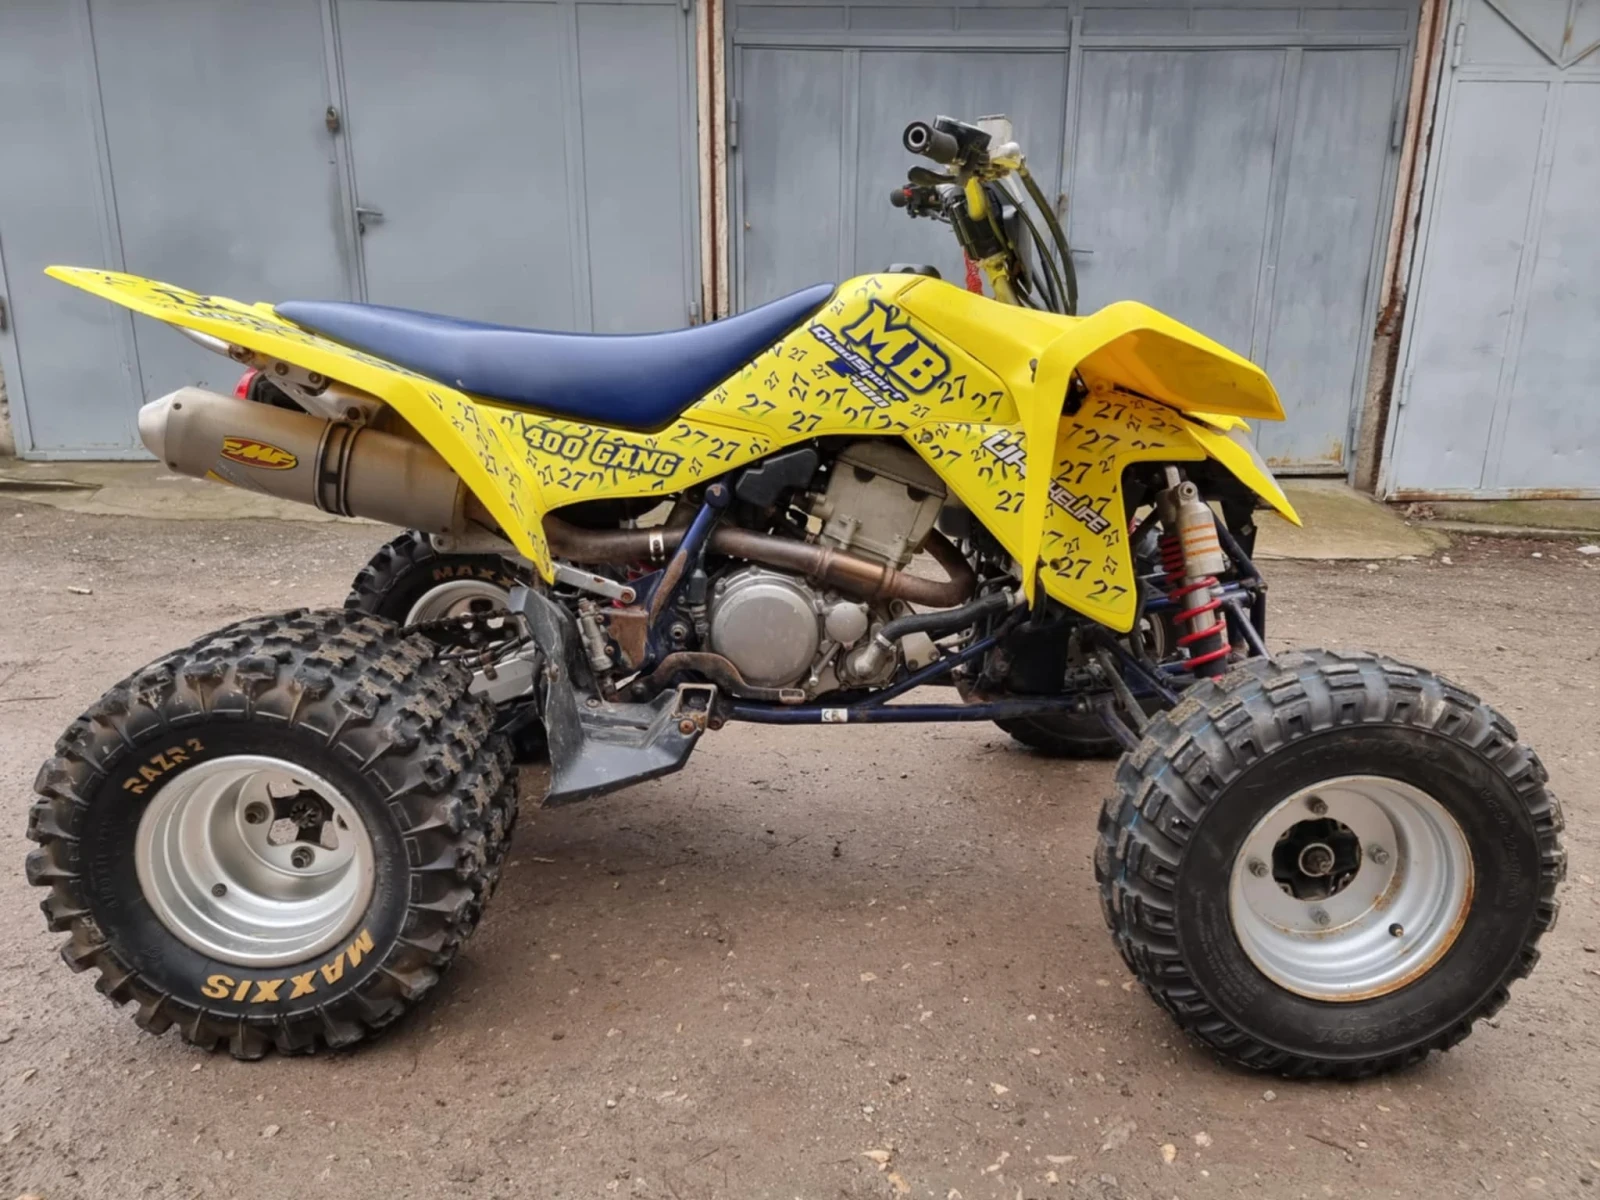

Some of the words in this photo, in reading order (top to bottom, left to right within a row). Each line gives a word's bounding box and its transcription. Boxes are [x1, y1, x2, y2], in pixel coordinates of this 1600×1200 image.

[788, 347, 808, 362] 27
[842, 300, 948, 393] MB
[810, 324, 907, 401] QuadSport
[811, 364, 830, 380] 27
[764, 370, 780, 391] 27
[788, 372, 810, 402] 27
[938, 375, 967, 404] 27
[714, 386, 728, 404] 27
[738, 394, 777, 417] 27
[815, 388, 849, 411] 27
[971, 391, 1004, 414] 27
[787, 410, 823, 432] 27
[843, 406, 876, 428] 27
[910, 404, 930, 418] 27
[1093, 400, 1127, 420] 27
[671, 424, 709, 447] 27
[1077, 429, 1120, 453] 27
[524, 426, 587, 460] 400
[591, 442, 681, 476] GANG
[526, 450, 538, 468] 27
[707, 438, 740, 461] 27
[538, 465, 554, 486] 27
[689, 457, 703, 476] 27
[1056, 460, 1093, 484] 27
[1099, 454, 1115, 474] 27
[557, 467, 588, 491] 27
[995, 490, 1025, 513] 27
[1063, 537, 1080, 554] 27
[1103, 529, 1120, 547] 27
[433, 565, 516, 588] MAXX
[1056, 556, 1092, 580] 27
[1103, 555, 1118, 575] 27
[1086, 579, 1128, 602] 27
[122, 746, 190, 794] RAZR
[186, 738, 205, 751] 2
[201, 928, 375, 1003] MAXXIS
